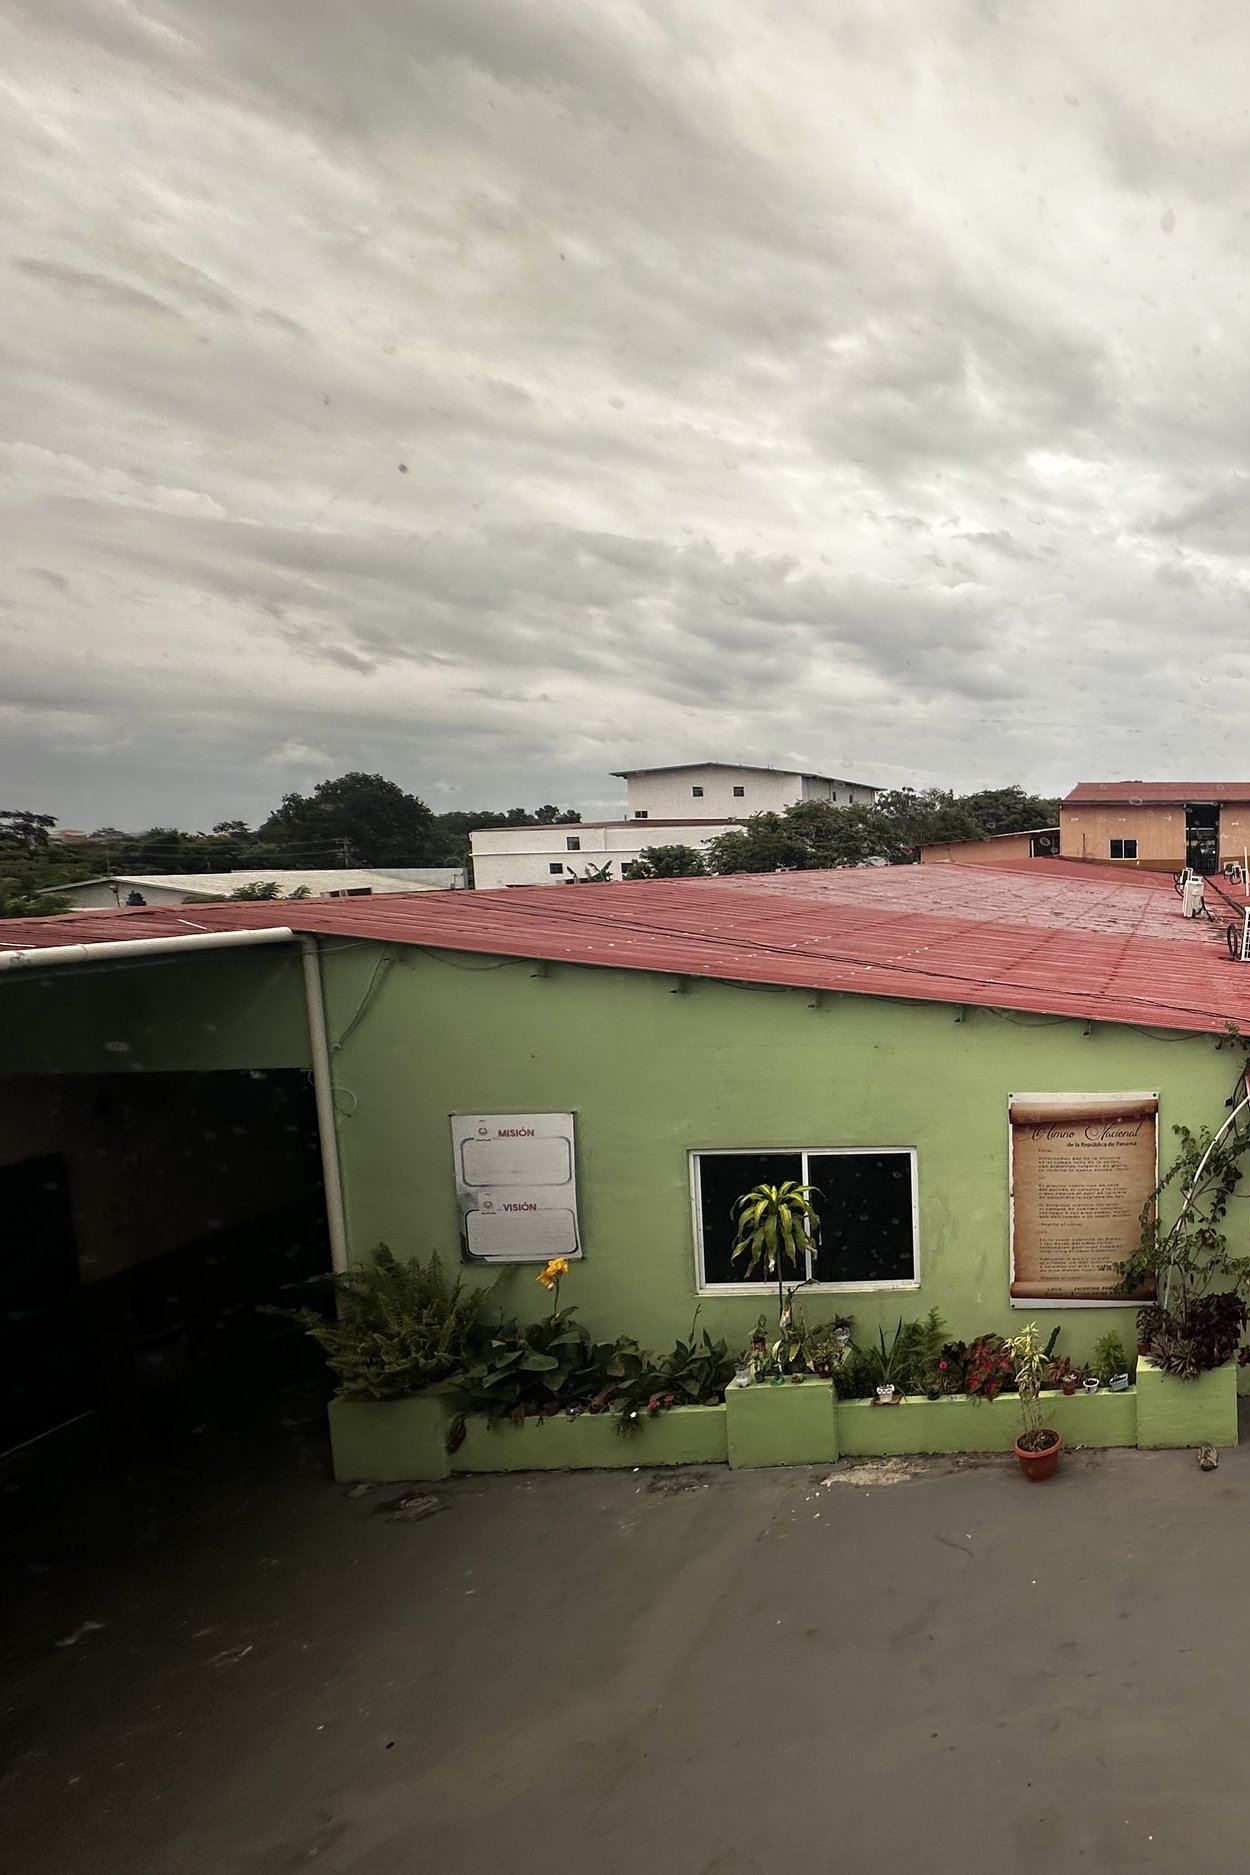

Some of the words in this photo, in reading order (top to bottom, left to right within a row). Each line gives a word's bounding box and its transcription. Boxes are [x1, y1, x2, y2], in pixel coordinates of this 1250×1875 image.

[498, 1127, 535, 1138] MISIÓN
[1029, 1122, 1075, 1140] Himno
[1085, 1122, 1142, 1140] Nacional
[503, 1202, 537, 1212] VISIÓN
